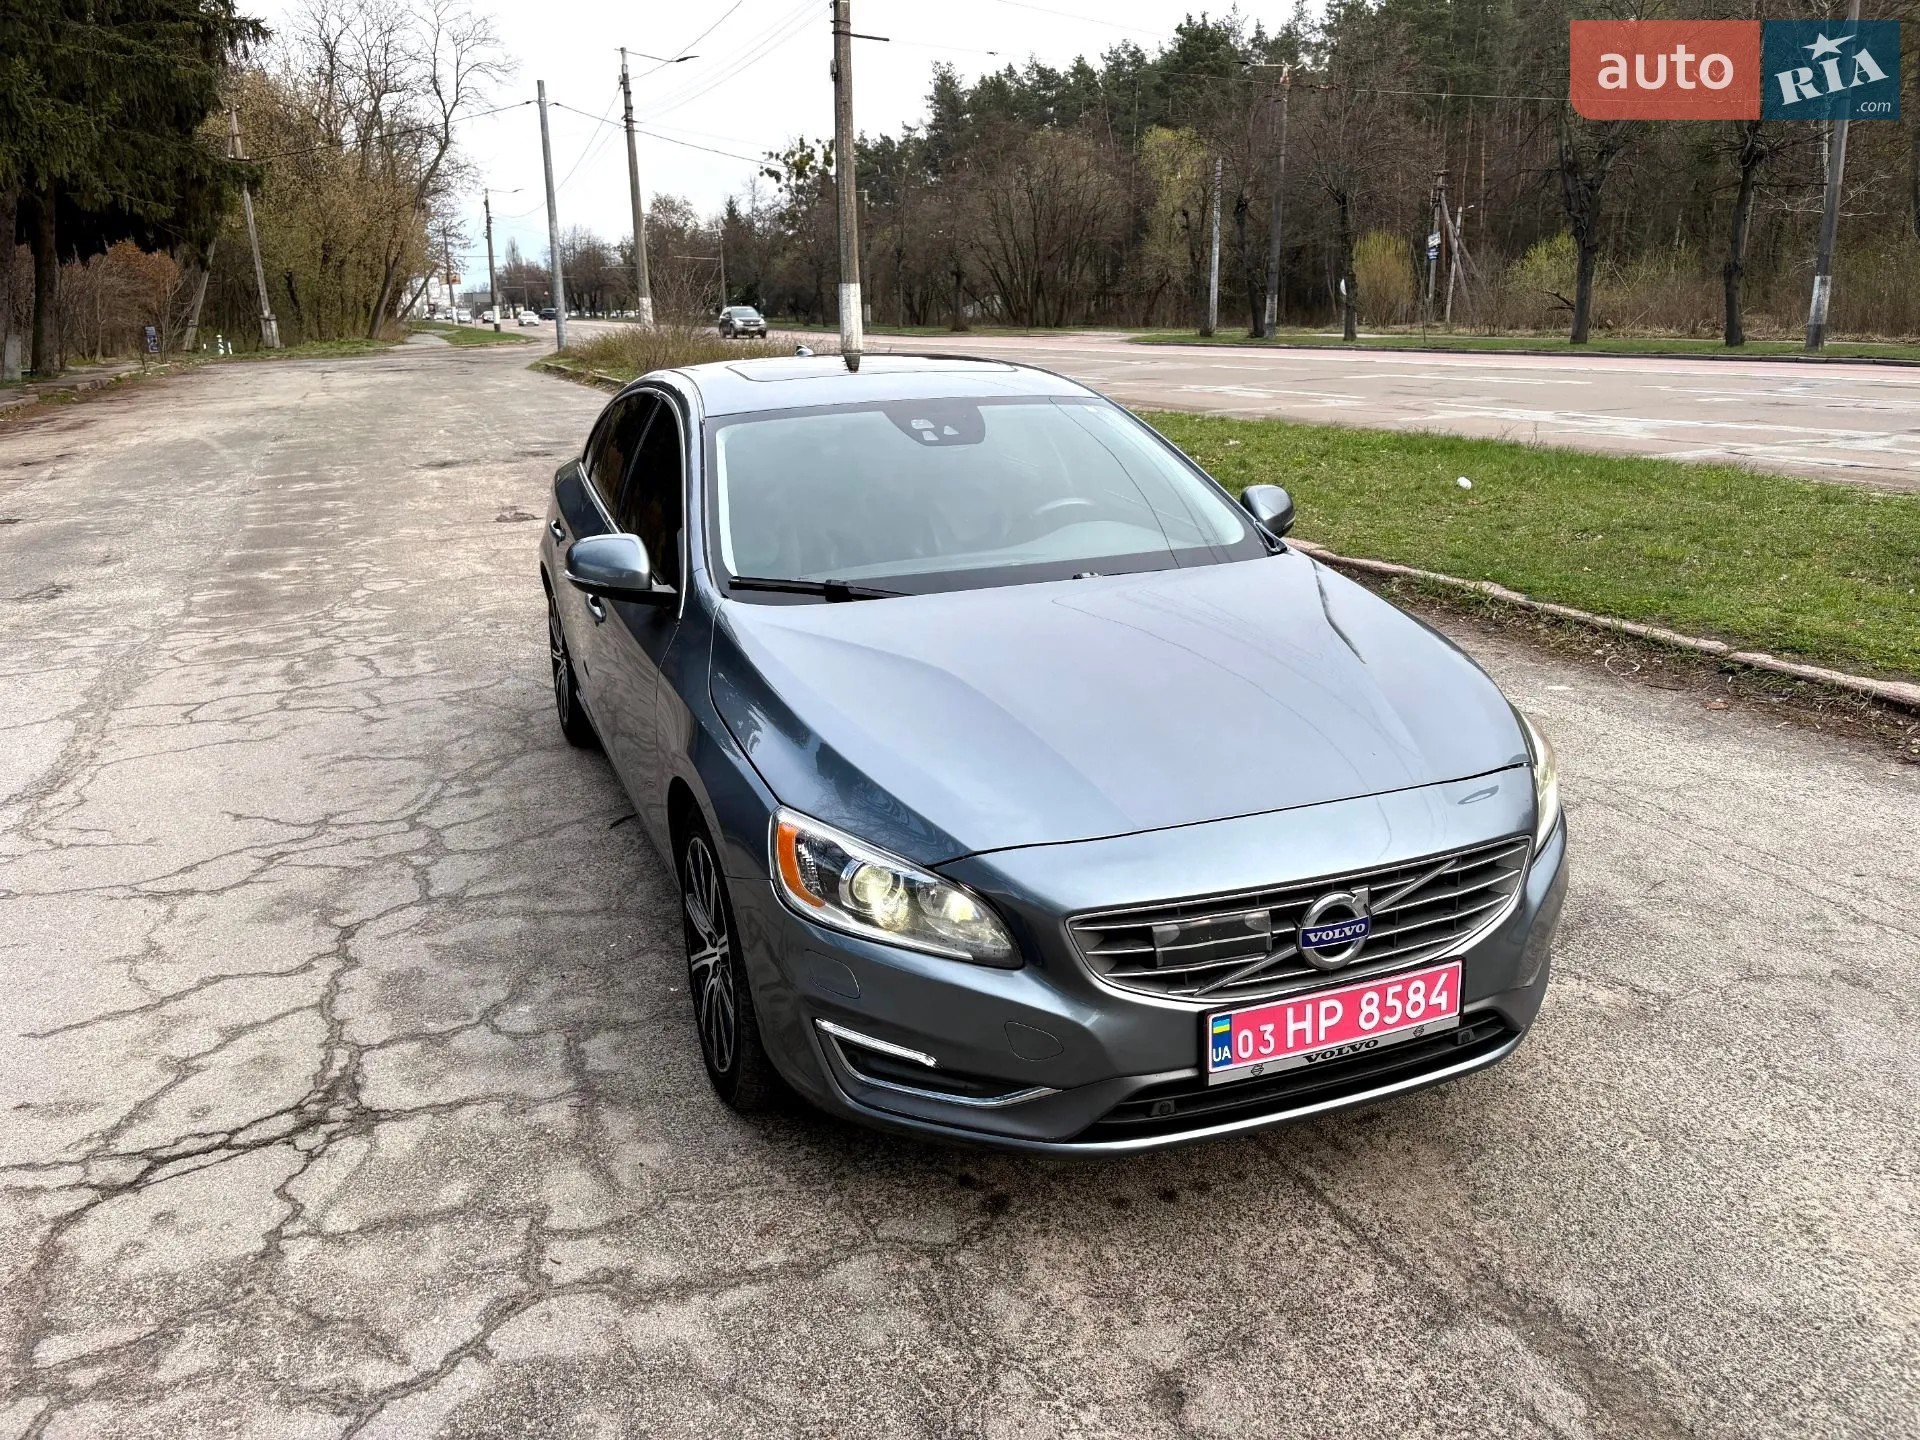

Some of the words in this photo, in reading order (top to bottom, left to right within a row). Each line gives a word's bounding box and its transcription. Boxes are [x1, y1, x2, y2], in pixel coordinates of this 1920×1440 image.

[1306, 923, 1366, 943] VOLVO
[1237, 1023, 1275, 1059] 03
[1286, 999, 1343, 1049] HP
[1358, 972, 1449, 1031] 8584
[1212, 1045, 1232, 1062] UA
[1303, 1039, 1379, 1063] VOLVO
